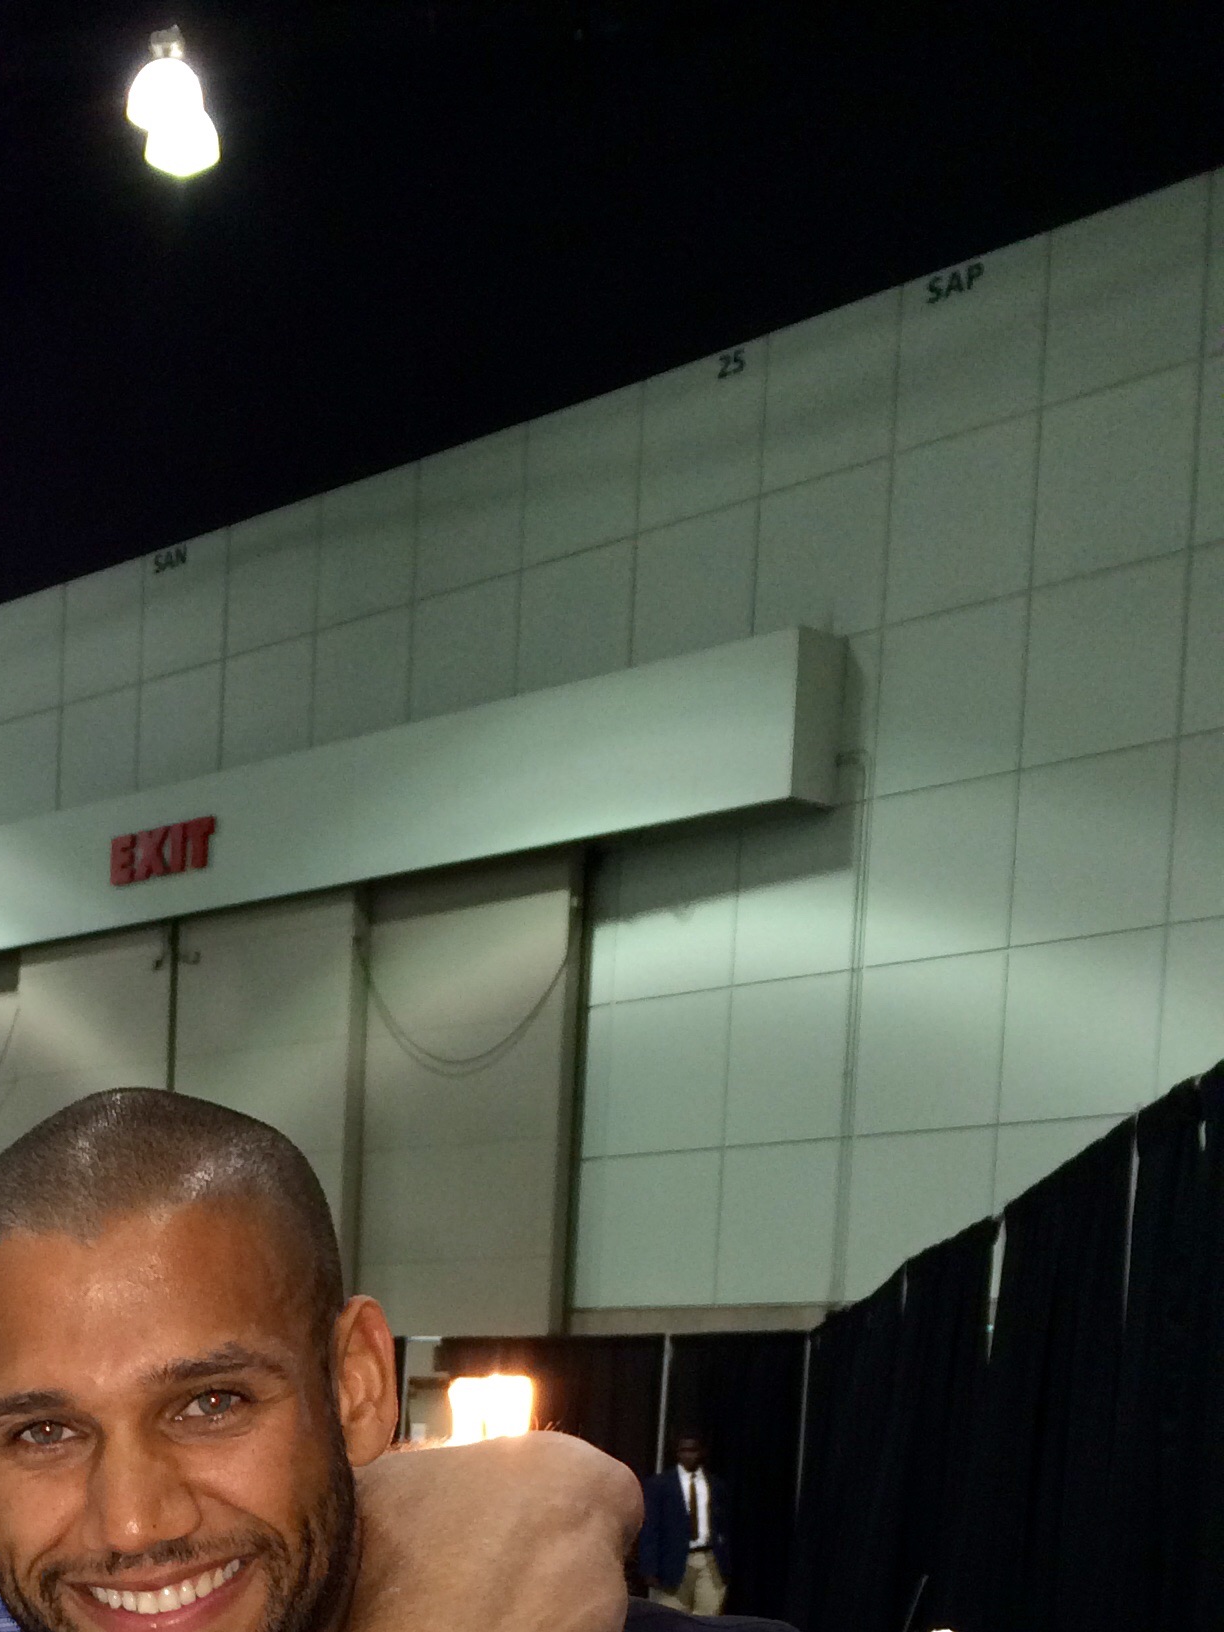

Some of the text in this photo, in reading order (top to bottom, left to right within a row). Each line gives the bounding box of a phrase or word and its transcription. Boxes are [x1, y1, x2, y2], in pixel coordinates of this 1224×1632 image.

[926, 262, 985, 304] SAP
[717, 350, 746, 379] 25
[110, 815, 217, 886] EXIT
